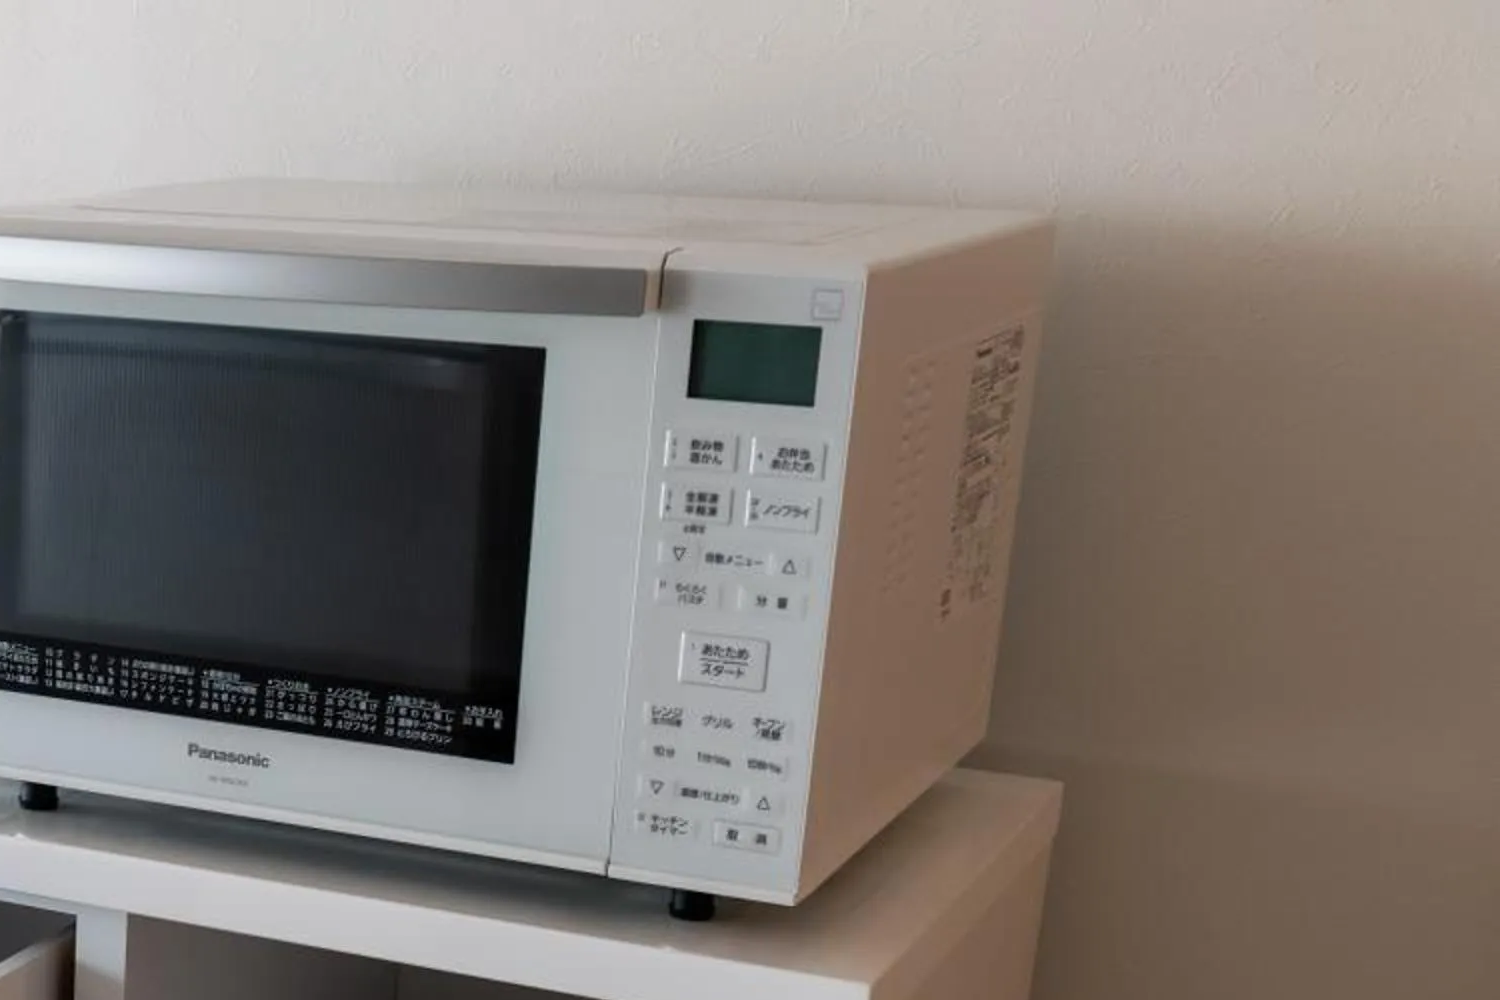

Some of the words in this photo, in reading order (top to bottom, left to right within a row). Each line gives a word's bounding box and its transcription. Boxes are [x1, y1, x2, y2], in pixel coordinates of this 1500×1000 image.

[700, 643, 750, 660] あたため
[700, 663, 745, 679] スタート
[188, 742, 270, 768] Panasonic
